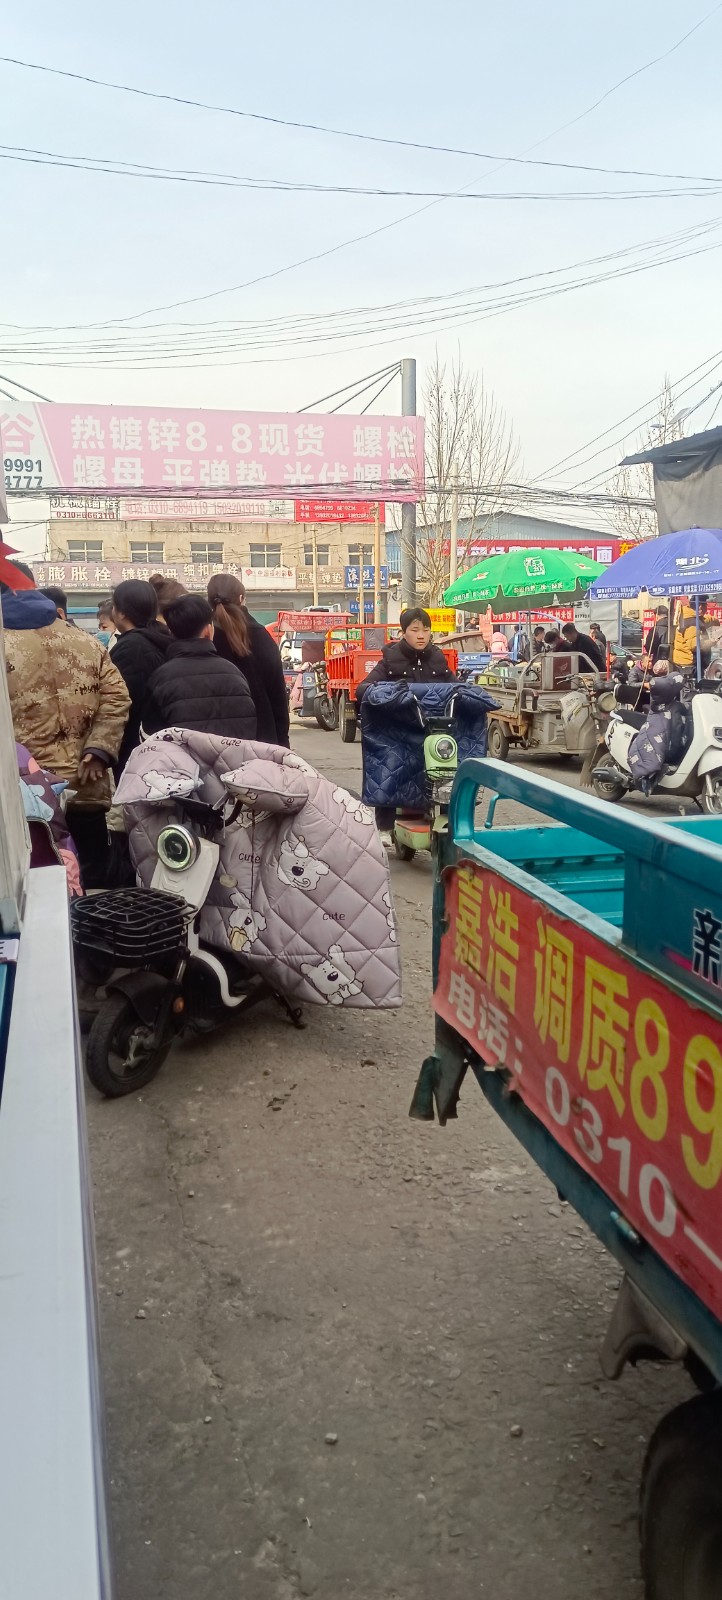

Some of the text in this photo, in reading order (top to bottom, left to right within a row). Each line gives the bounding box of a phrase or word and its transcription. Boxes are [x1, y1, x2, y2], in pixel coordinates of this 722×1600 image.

[71, 415, 416, 458] 热镀锌8.8现货 螺栓
[3, 458, 42, 472] 9991
[73, 454, 144, 487] 螺母
[162, 458, 267, 487] 平弹垫
[48, 566, 112, 581] 膨胀栓
